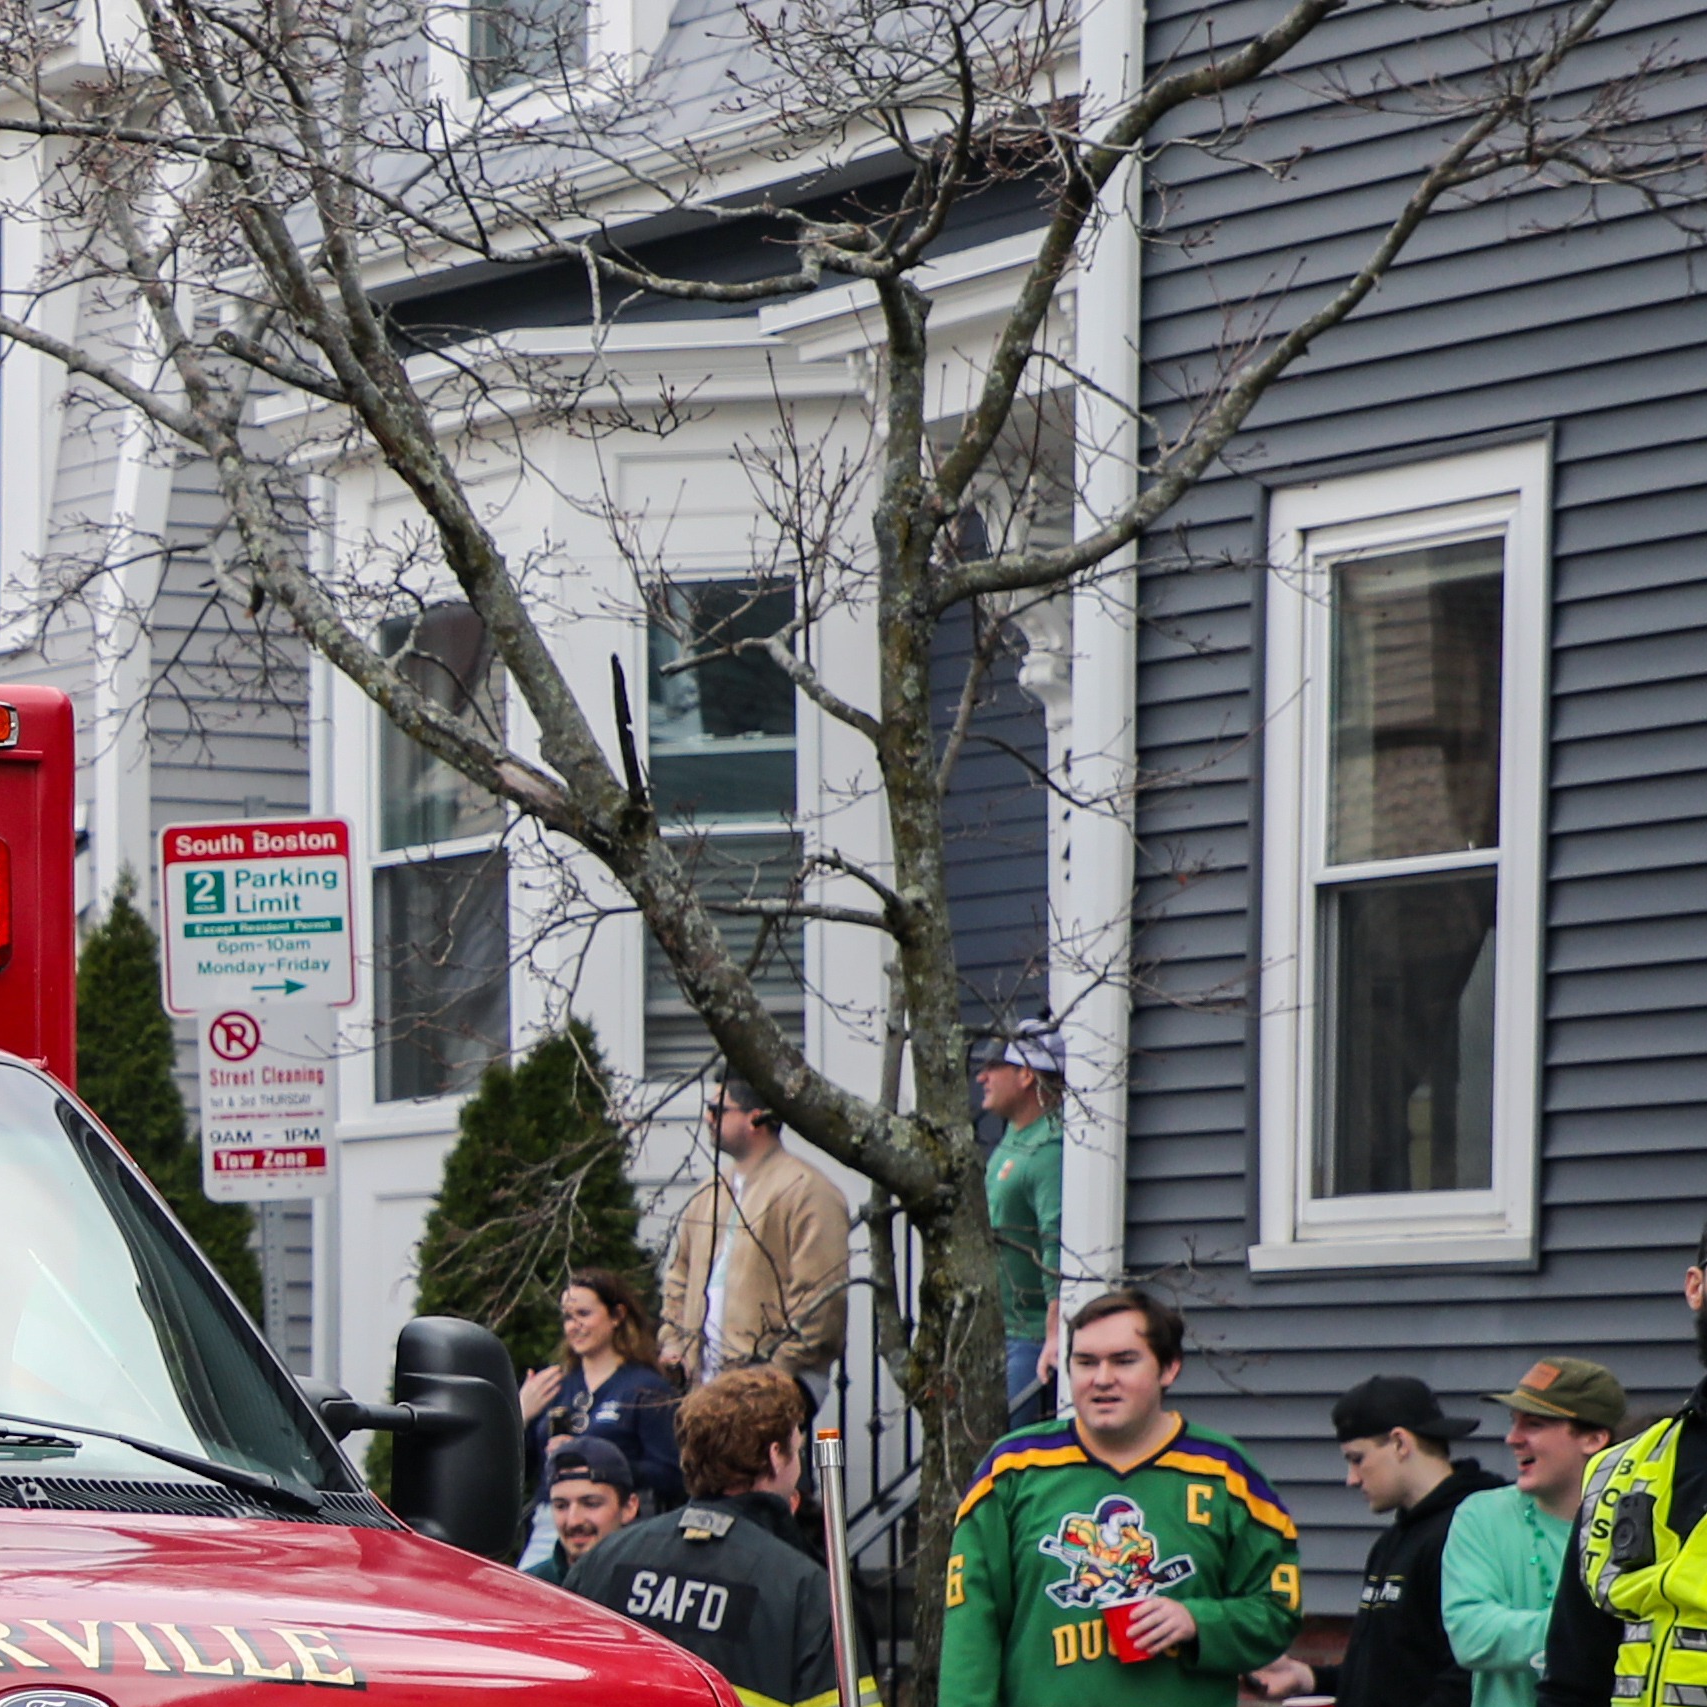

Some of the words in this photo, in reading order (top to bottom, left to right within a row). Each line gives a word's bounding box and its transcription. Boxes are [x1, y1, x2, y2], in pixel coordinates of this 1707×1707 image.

[175, 833, 245, 857] South
[252, 829, 337, 853] Boston
[192, 872, 216, 903] 2
[235, 867, 337, 890] Parking
[235, 892, 301, 914] Limit
[195, 924, 235, 937] Except
[239, 920, 289, 933] Resident
[294, 920, 331, 930] Permit
[217, 937, 311, 955] 6pm-10am
[197, 957, 330, 976] Monday-Friday
[210, 1068, 255, 1088] Street
[262, 1065, 325, 1087] Cleaning
[260, 1093, 311, 1105] THURSDAY
[210, 1129, 253, 1144] 9AM
[284, 1127, 321, 1142] 1PM
[218, 1151, 255, 1169] Tow
[262, 1150, 308, 1168] Zone
[1187, 1483, 1213, 1525] C
[946, 1554, 965, 1608] 6
[1271, 1563, 1300, 1611] 9
[628, 1570, 729, 1632] SAFD
